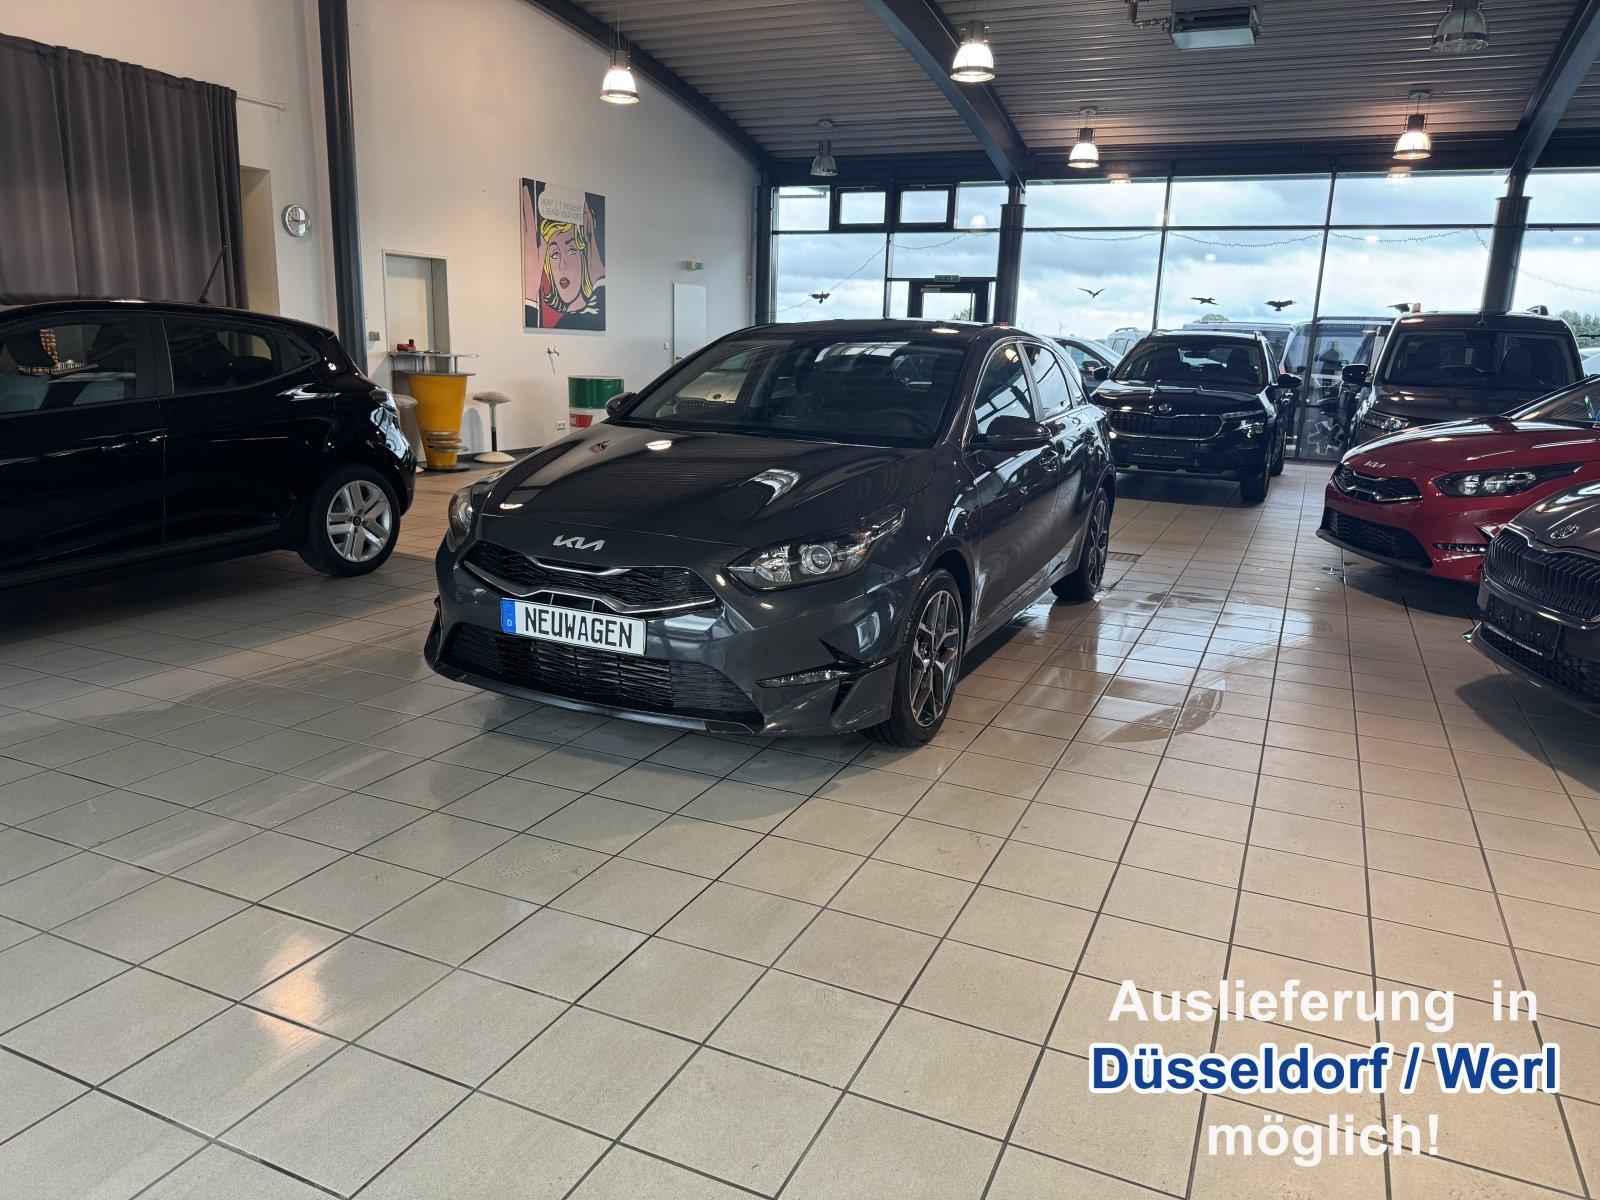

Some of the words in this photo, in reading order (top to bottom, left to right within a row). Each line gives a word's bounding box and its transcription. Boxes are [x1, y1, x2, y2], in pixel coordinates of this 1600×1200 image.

[553, 535, 605, 551] KIA
[507, 619, 512, 627] D
[524, 606, 633, 649] NEUWAGEN
